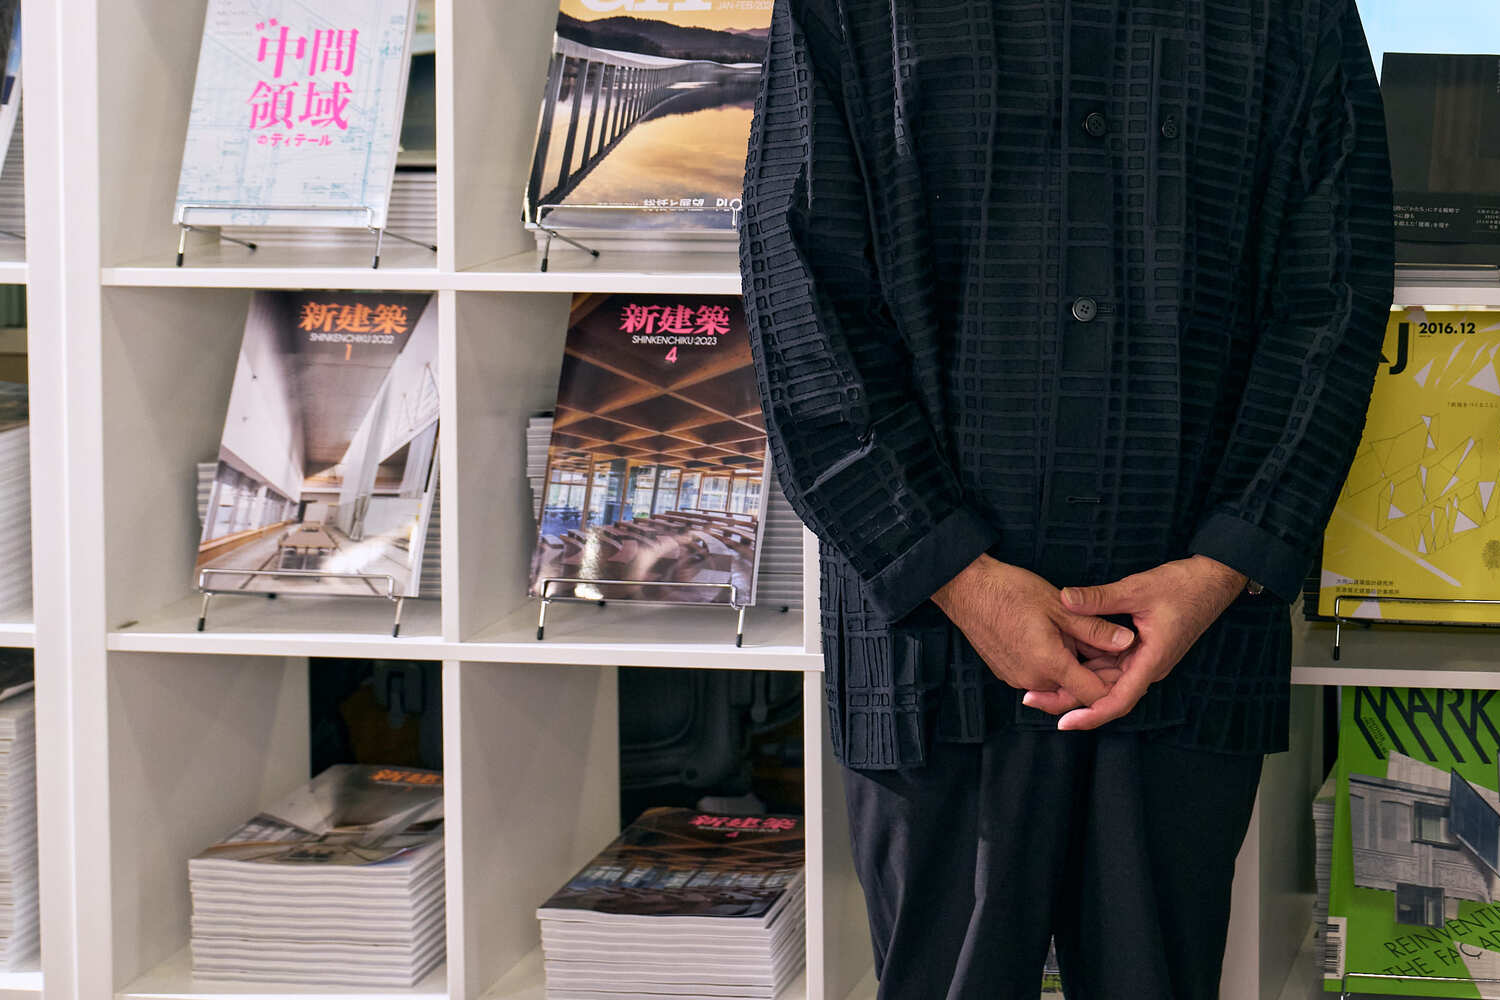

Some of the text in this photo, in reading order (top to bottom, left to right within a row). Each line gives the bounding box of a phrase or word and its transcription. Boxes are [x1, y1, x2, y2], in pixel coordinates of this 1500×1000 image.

[257, 26, 360, 79] 中間
[246, 80, 353, 130] 領域
[256, 133, 332, 147] のディテール
[297, 301, 409, 334] 新建築
[618, 303, 731, 335] 新建築
[1418, 322, 1476, 335] 2016.12
[664, 346, 678, 364] 4
[687, 814, 798, 831] 新建築
